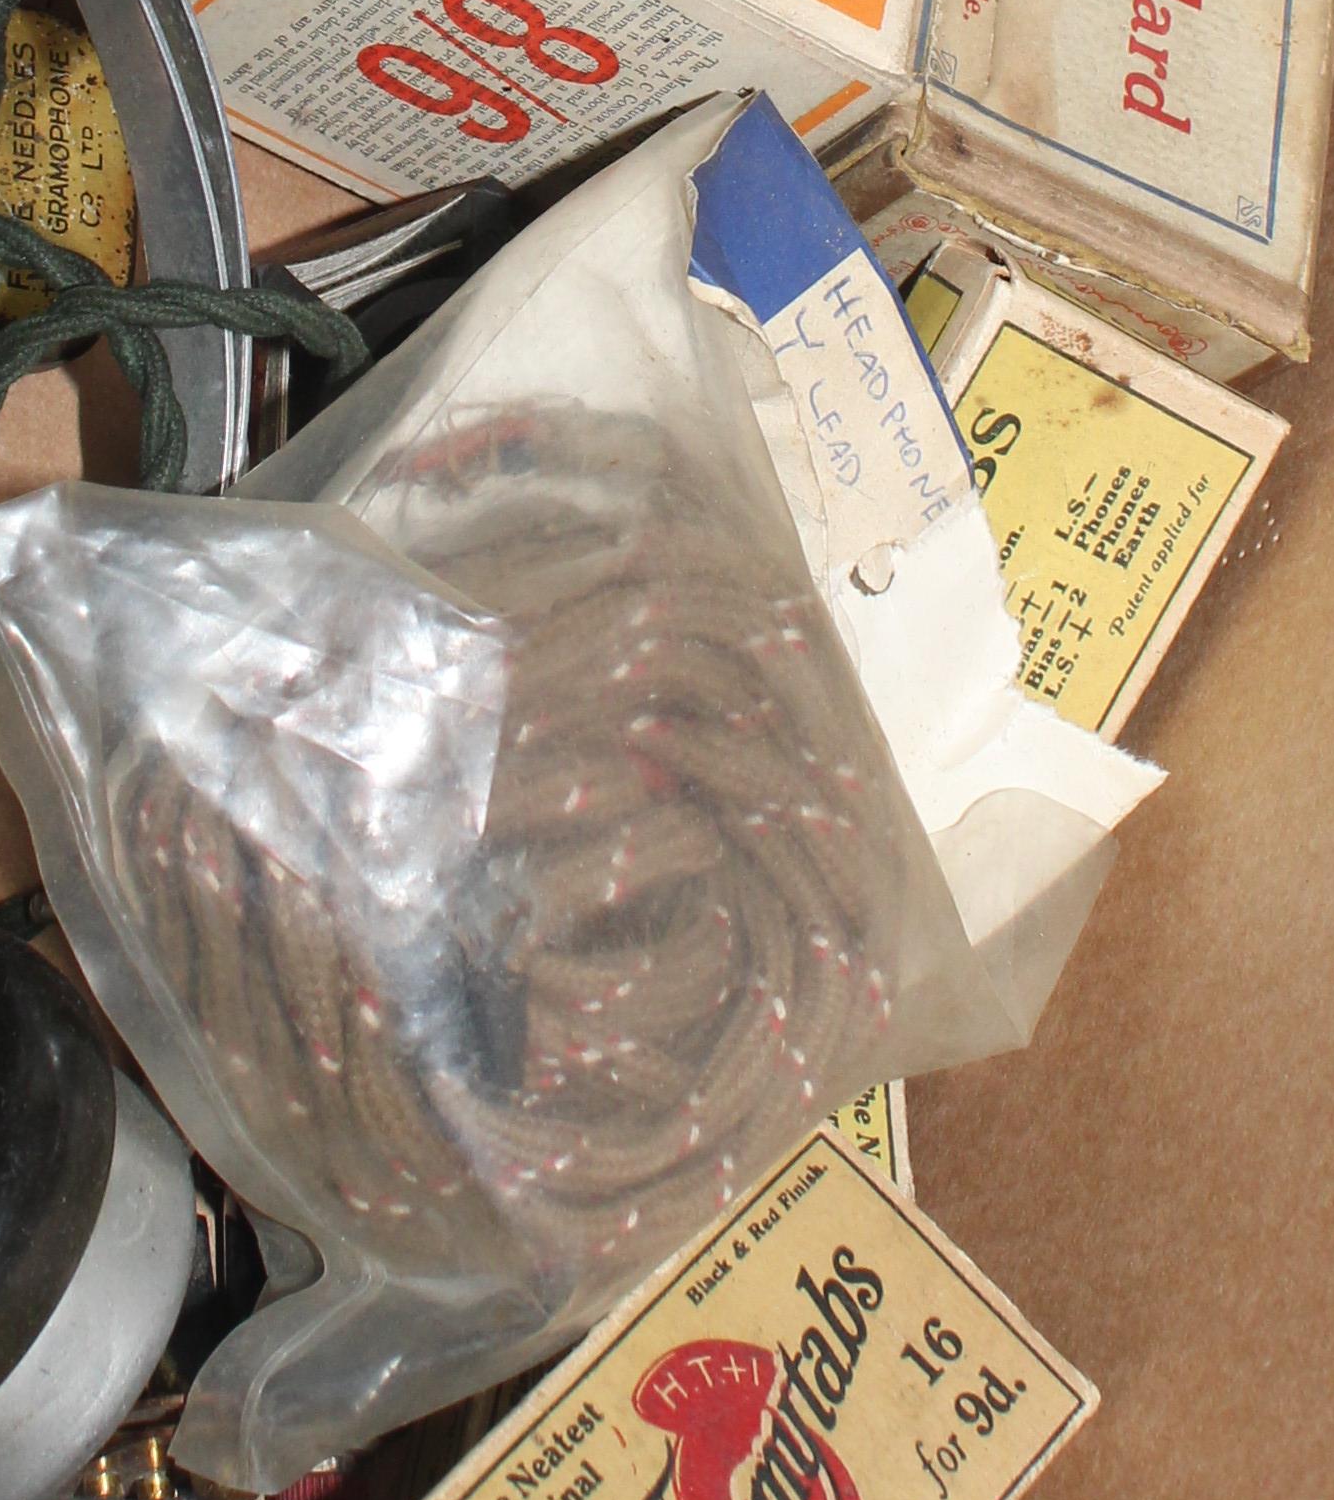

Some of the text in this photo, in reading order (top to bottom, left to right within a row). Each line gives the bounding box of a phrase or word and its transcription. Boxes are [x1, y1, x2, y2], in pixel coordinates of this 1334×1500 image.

[337, 6, 350, 17] or
[379, 6, 406, 25] such
[586, 0, 625, 32] re-sold
[603, 12, 638, 34] same,
[638, 4, 679, 30] hands
[289, 15, 311, 33] any
[307, 16, 340, 41] dealer
[347, 25, 380, 47] seller,
[626, 31, 644, 40] it
[633, 13, 693, 56] Purchaser
[273, 34, 288, 48] of
[295, 40, 312, 48] is
[326, 32, 348, 47] for
[650, 22, 709, 61] Licensees
[697, 30, 723, 47] this
[253, 47, 274, 60] the
[304, 46, 351, 83] purchaser
[666, 49, 699, 66] box,
[222, 62, 252, 84] above
[248, 47, 298, 87] authorised
[266, 46, 330, 92] infringement
[633, 63, 648, 77] of
[238, 83, 254, 93] to
[291, 83, 303, 94] or
[611, 76, 634, 90] the
[253, 91, 267, 104] of
[565, 88, 588, 107] and
[573, 56, 719, 158] The Manufacturers of the
[575, 92, 610, 116] above
[13, 42, 36, 182] NEEDLES
[48, 49, 71, 235] GRAMOPHONE
[539, 146, 559, 159] are
[509, 147, 532, 164] and
[809, 378, 862, 487] LEAD
[1073, 465, 1132, 553] Phones
[1092, 475, 1151, 563] Phones
[1112, 502, 1161, 570] Earth
[1108, 473, 1211, 638] Patent applied for
[1024, 637, 1063, 691] Bias
[685, 1162, 829, 1307] Black & Red Finish.
[900, 1315, 964, 1387] 16
[915, 1364, 1028, 1499] for 9d.
[504, 1400, 607, 1500] Neatest
